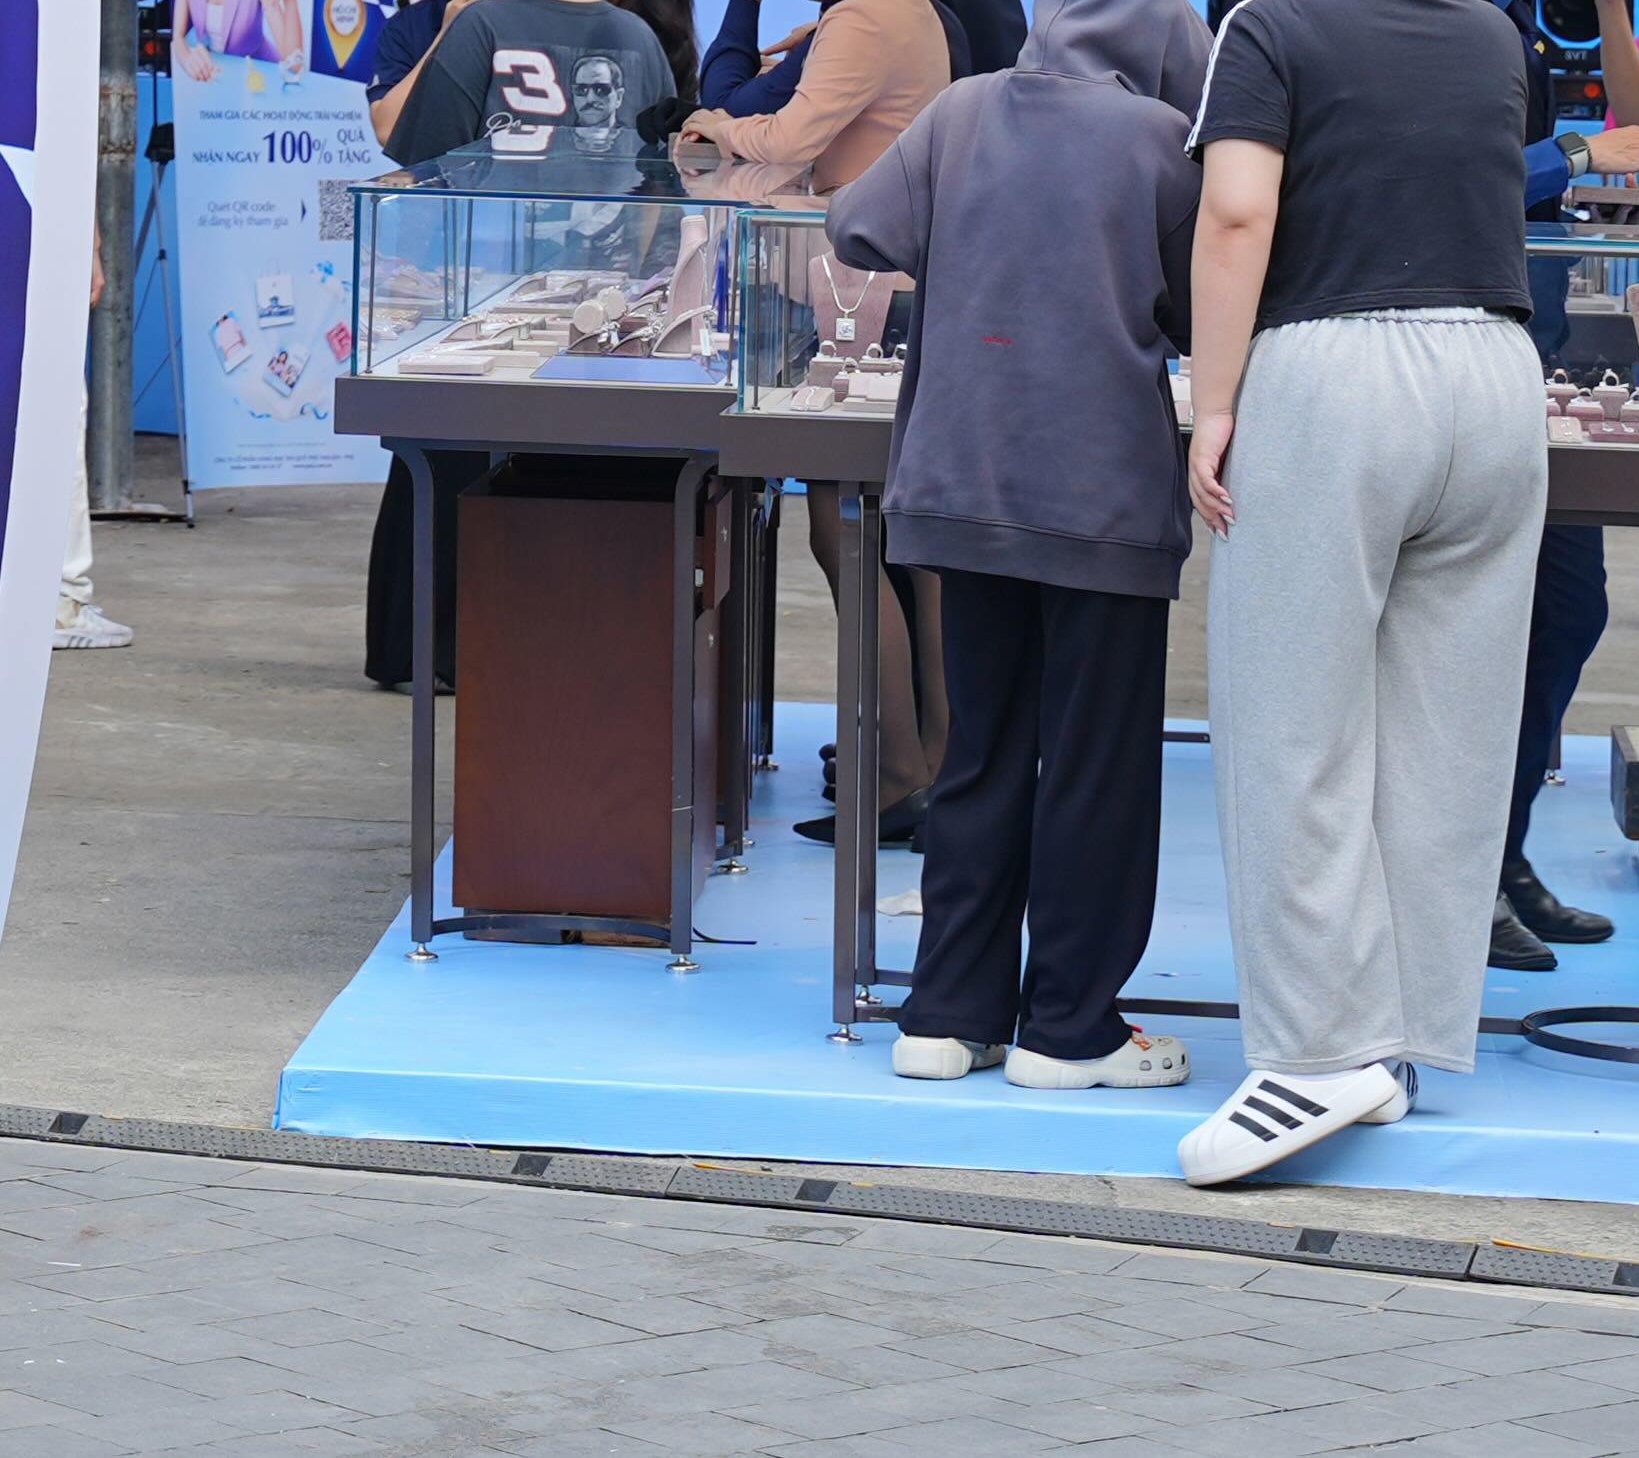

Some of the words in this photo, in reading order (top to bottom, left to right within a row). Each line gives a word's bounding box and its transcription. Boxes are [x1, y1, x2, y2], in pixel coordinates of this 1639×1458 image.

[492, 48, 568, 117] 3
[227, 151, 262, 164] NGAY
[263, 130, 333, 165] 100%
[337, 127, 366, 144] QUÀ
